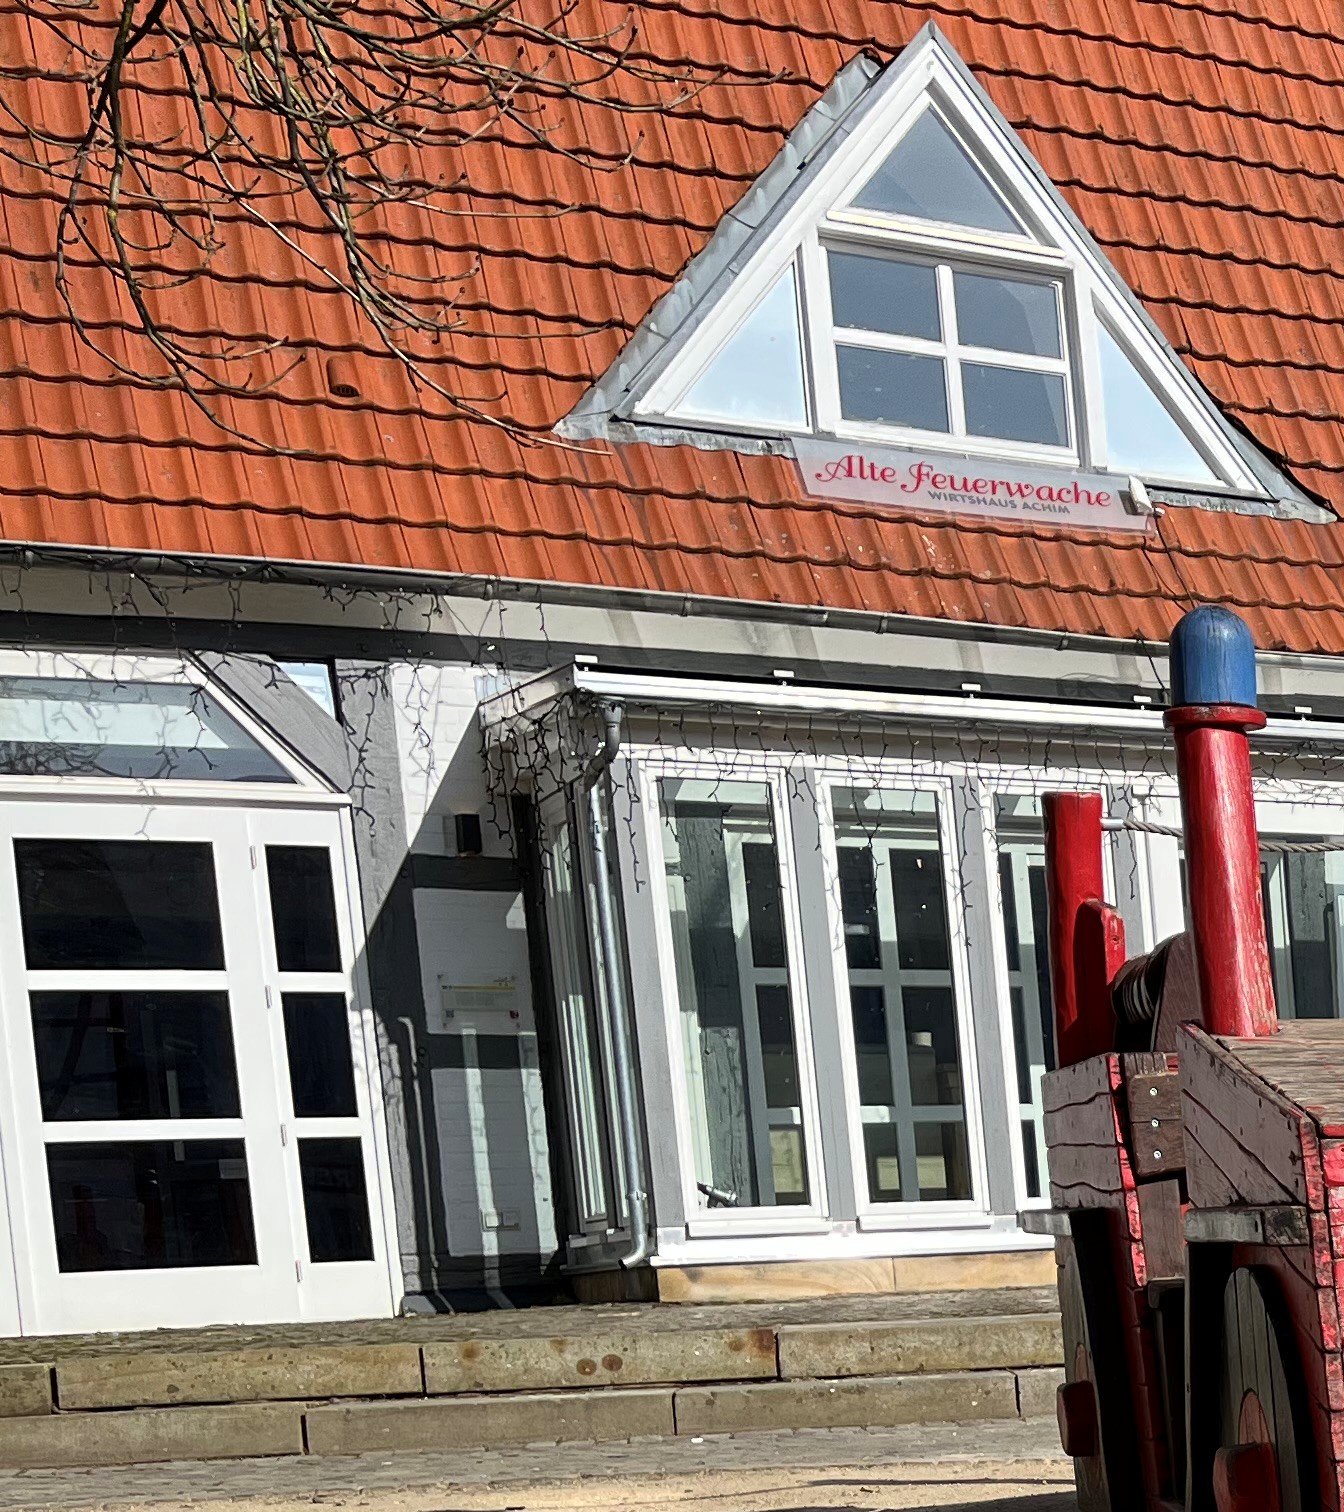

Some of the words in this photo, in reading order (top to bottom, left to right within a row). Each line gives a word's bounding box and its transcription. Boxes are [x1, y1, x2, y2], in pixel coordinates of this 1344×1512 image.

[815, 454, 897, 483] Alte
[900, 461, 1111, 508] Feuerwache
[927, 490, 1018, 510] WIRTSHAUS
[1022, 501, 1070, 515] ACHIM
